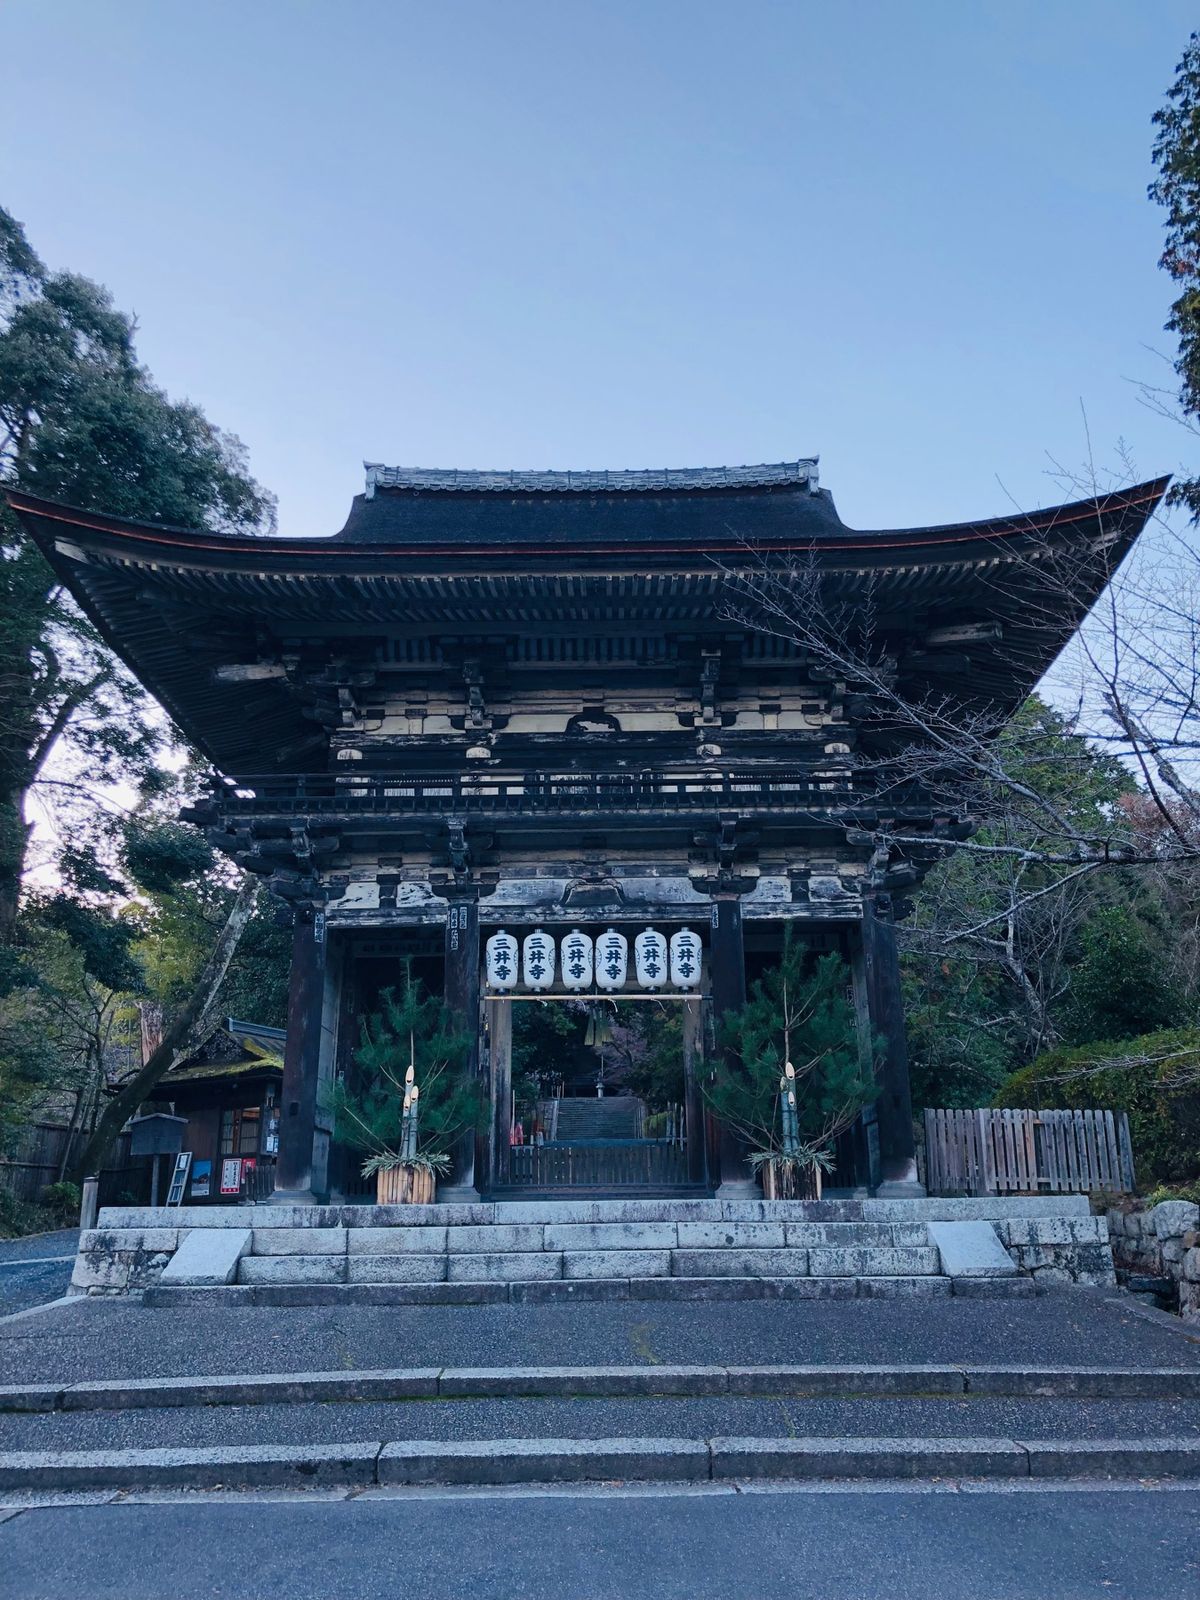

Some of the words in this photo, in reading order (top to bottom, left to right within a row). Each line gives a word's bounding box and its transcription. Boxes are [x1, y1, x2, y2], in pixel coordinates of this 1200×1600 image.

[493, 938, 511, 980] 三井寺
[528, 937, 546, 980] 三井寺
[567, 937, 586, 979] 三井寺
[605, 937, 623, 980] 三井寺
[642, 936, 661, 979] 三井寺
[677, 936, 695, 979] 三井寺
